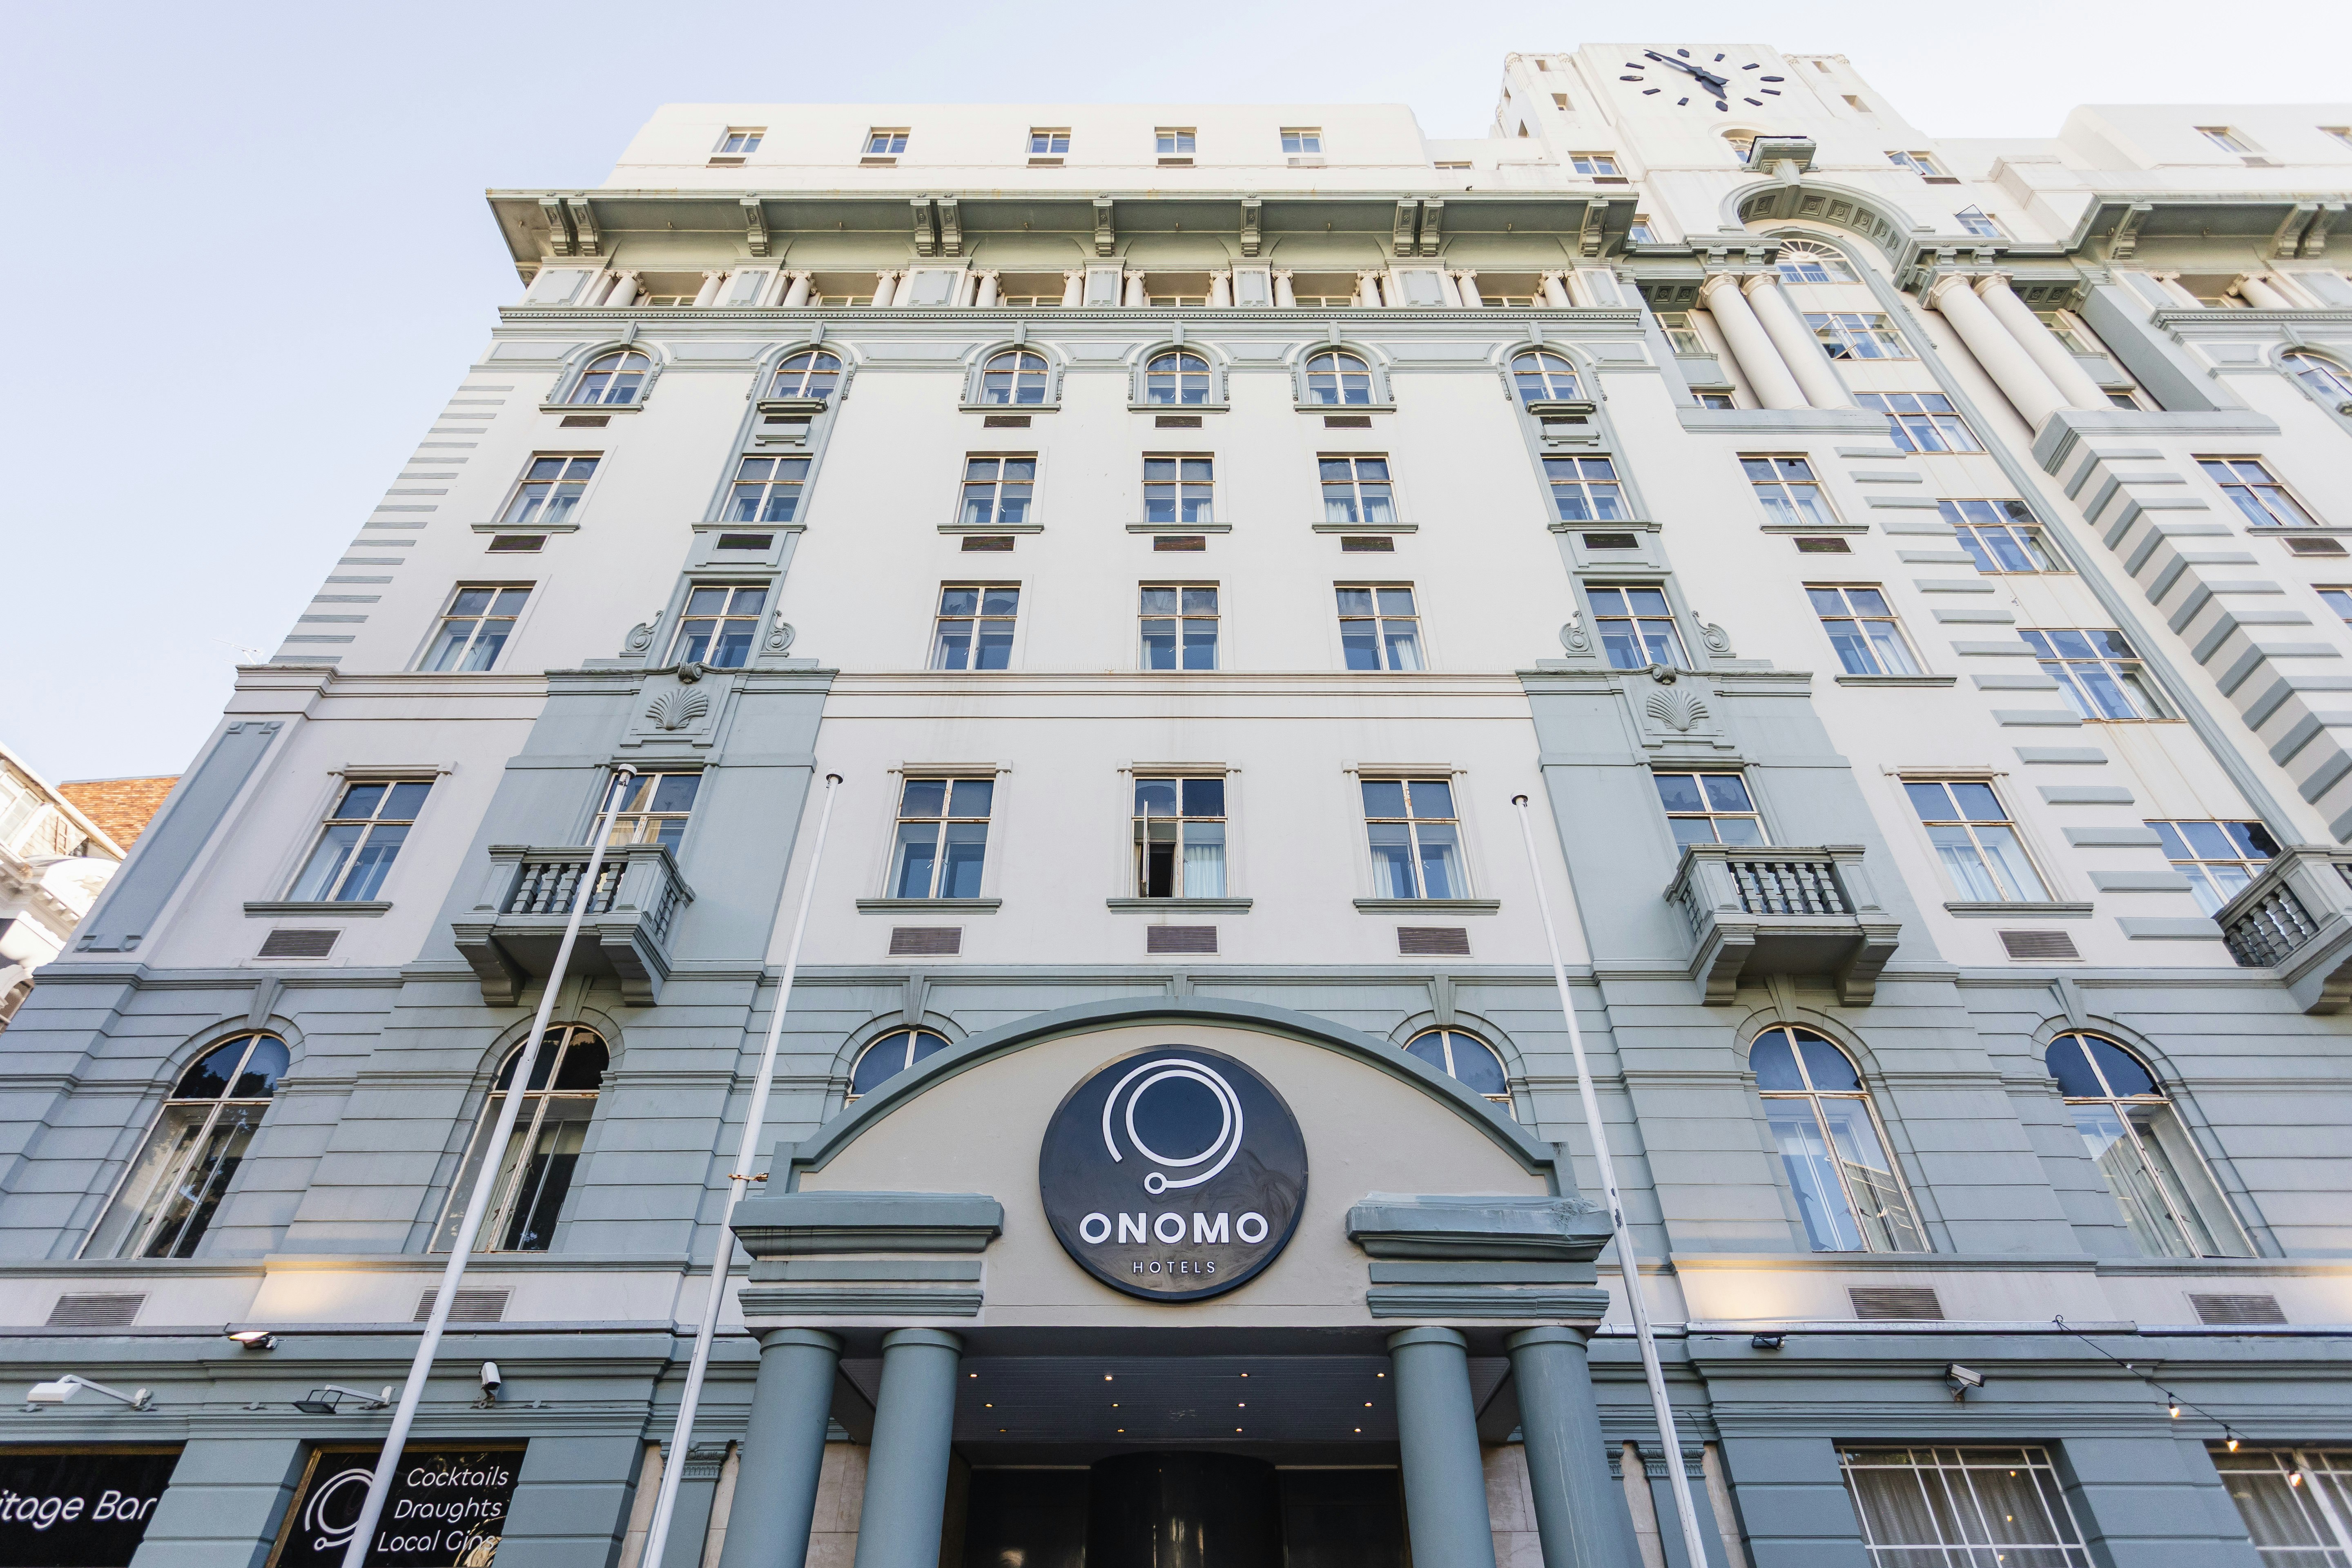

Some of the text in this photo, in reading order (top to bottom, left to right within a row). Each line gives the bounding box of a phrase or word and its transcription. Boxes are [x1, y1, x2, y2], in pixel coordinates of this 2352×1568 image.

[1079, 1212, 1269, 1244] ONOMO
[1133, 1261, 1215, 1274] HOTELS
[407, 1466, 509, 1487] Cocktails
[92, 1490, 158, 1520] Bar
[394, 1497, 503, 1523] Draughts
[377, 1529, 496, 1552] Local Gins
